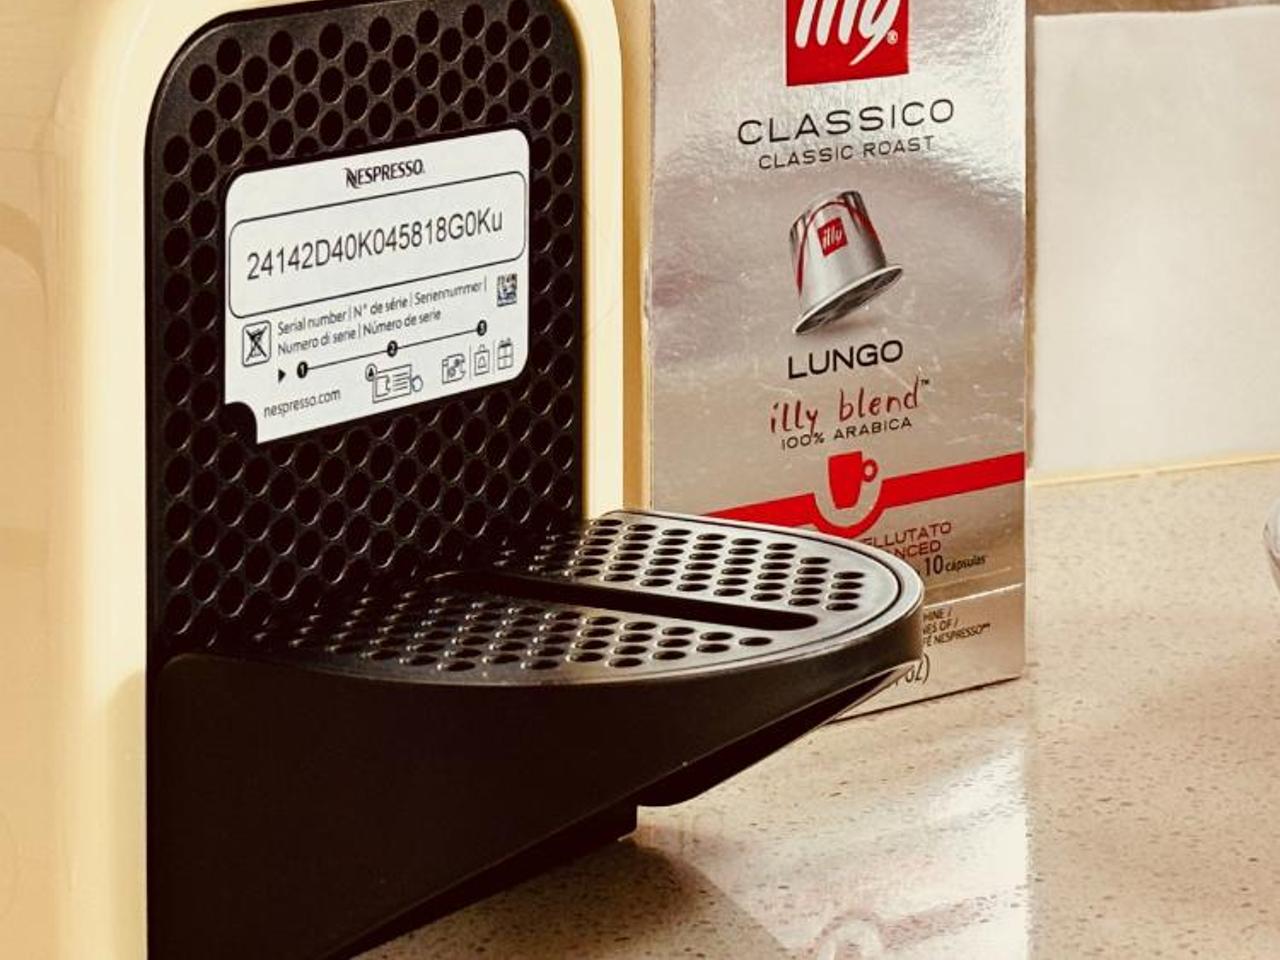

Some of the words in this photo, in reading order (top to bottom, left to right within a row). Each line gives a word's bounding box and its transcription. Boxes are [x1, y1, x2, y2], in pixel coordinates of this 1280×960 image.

[737, 98, 955, 145] CLASSICO
[758, 144, 854, 170] CLASSIC
[863, 135, 936, 158] ROAST
[344, 158, 424, 189] NESPRESSO
[278, 316, 306, 336] Serial
[308, 310, 347, 329] number
[370, 302, 384, 315] de
[415, 281, 483, 305] Seriennummer
[278, 336, 319, 357] Numero
[321, 332, 331, 346] di
[333, 328, 357, 343] serie
[404, 314, 417, 327] de
[419, 308, 442, 324] serie
[787, 339, 904, 380] LUNGO
[264, 389, 341, 419] nespresso.com
[770, 399, 819, 437] illy
[781, 431, 826, 451] 100%
[833, 416, 913, 440] ARABICA
[925, 554, 944, 577] 10
